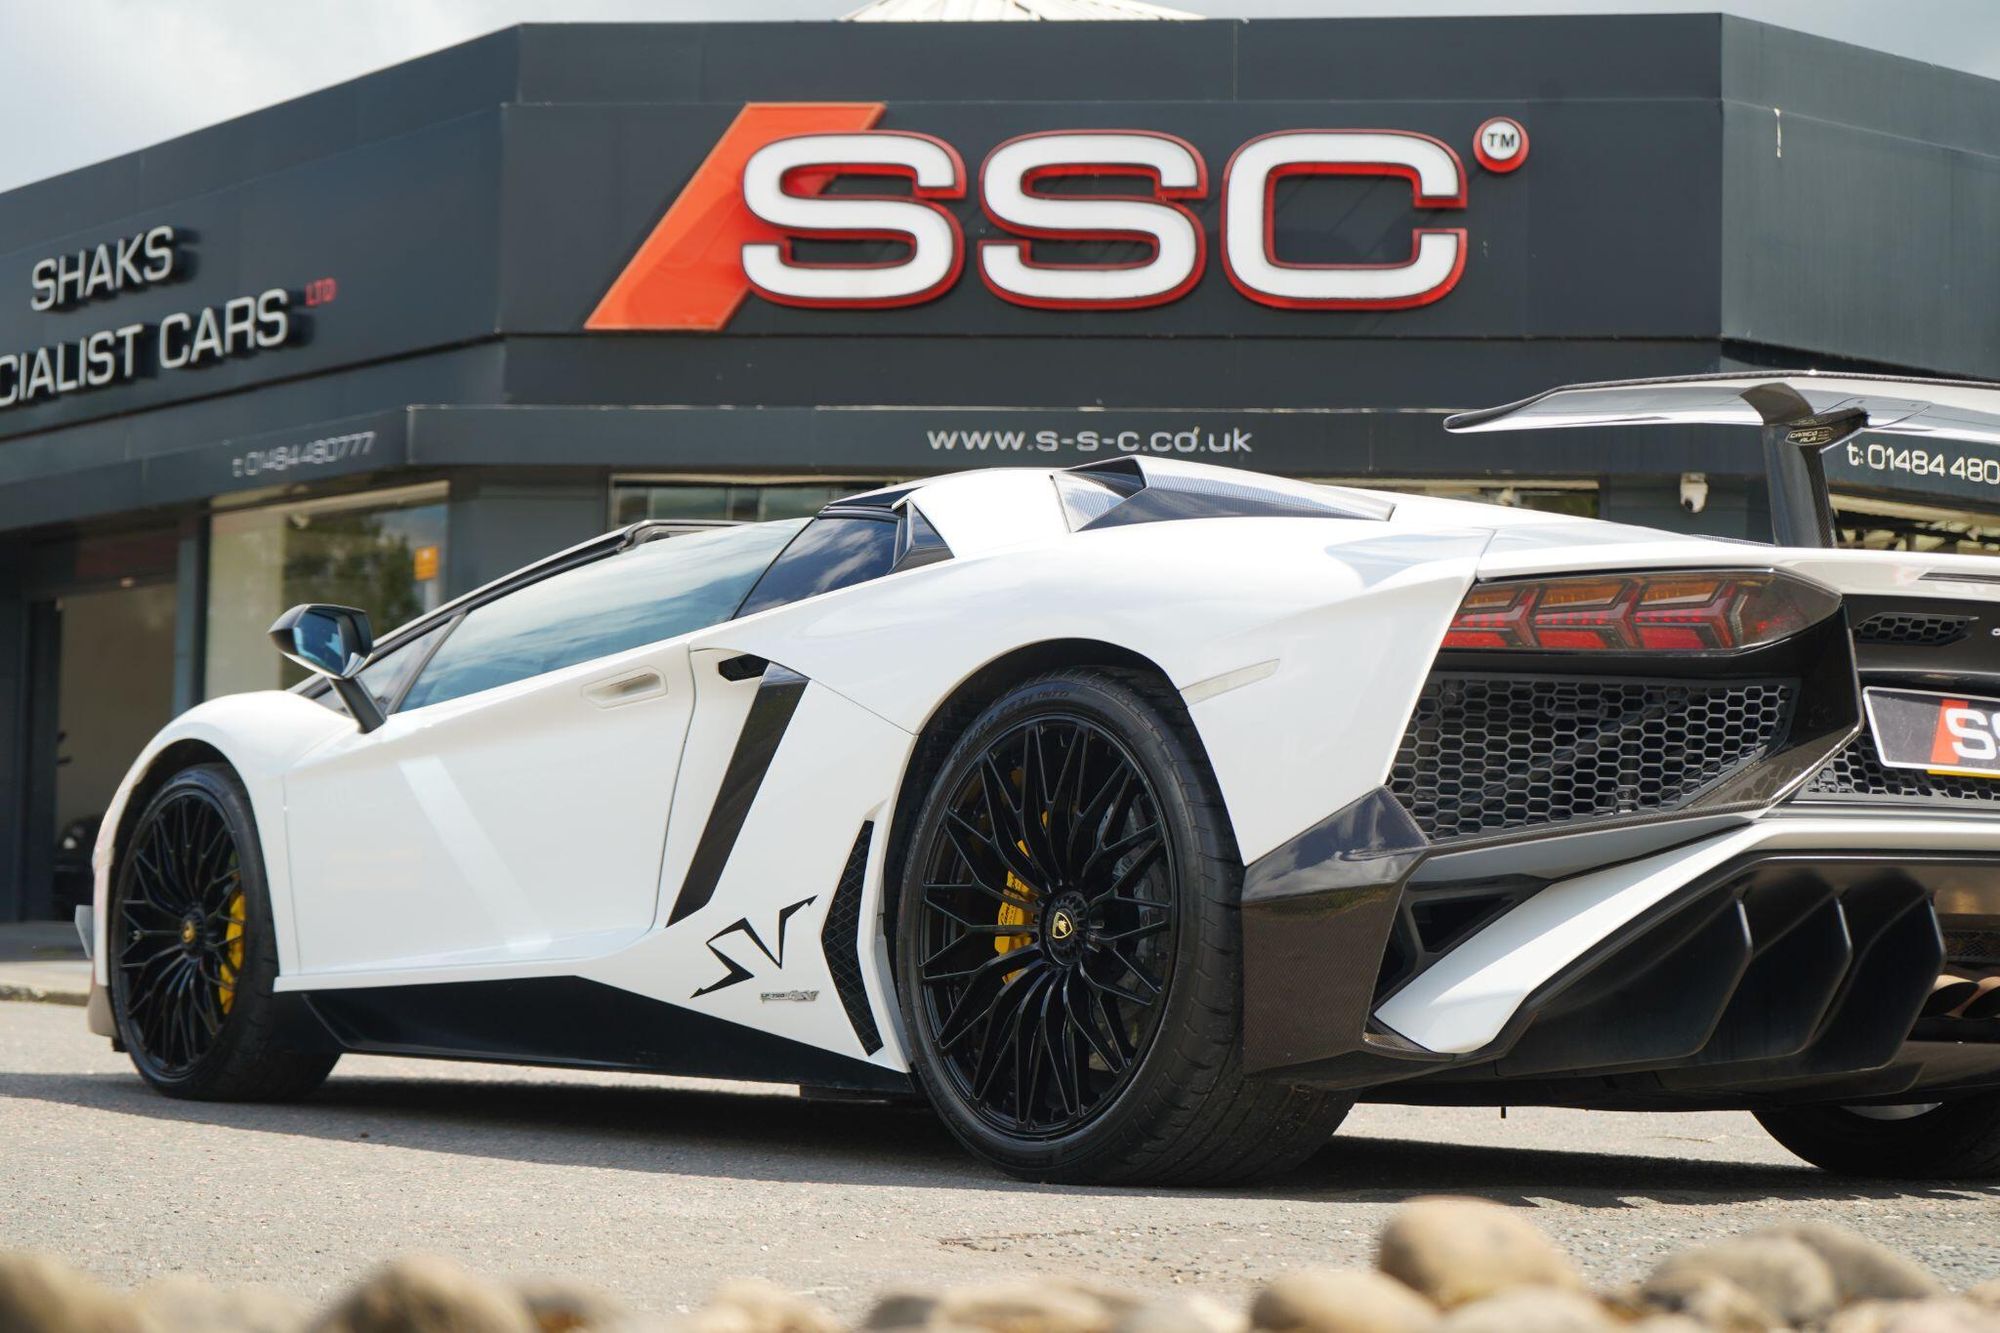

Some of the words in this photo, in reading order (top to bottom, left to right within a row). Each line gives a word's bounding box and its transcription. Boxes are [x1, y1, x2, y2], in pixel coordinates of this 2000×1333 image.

[1487, 133, 1515, 147] TM
[741, 129, 1468, 310] SSC
[31, 225, 174, 311] SHAKS
[159, 288, 289, 369] CARS
[305, 277, 338, 307] LTD
[926, 427, 1253, 452] www.s-s-c.co.uk
[1846, 441, 1864, 466] t:
[1867, 443, 1946, 477] 01484
[1945, 707, 2000, 760] S
